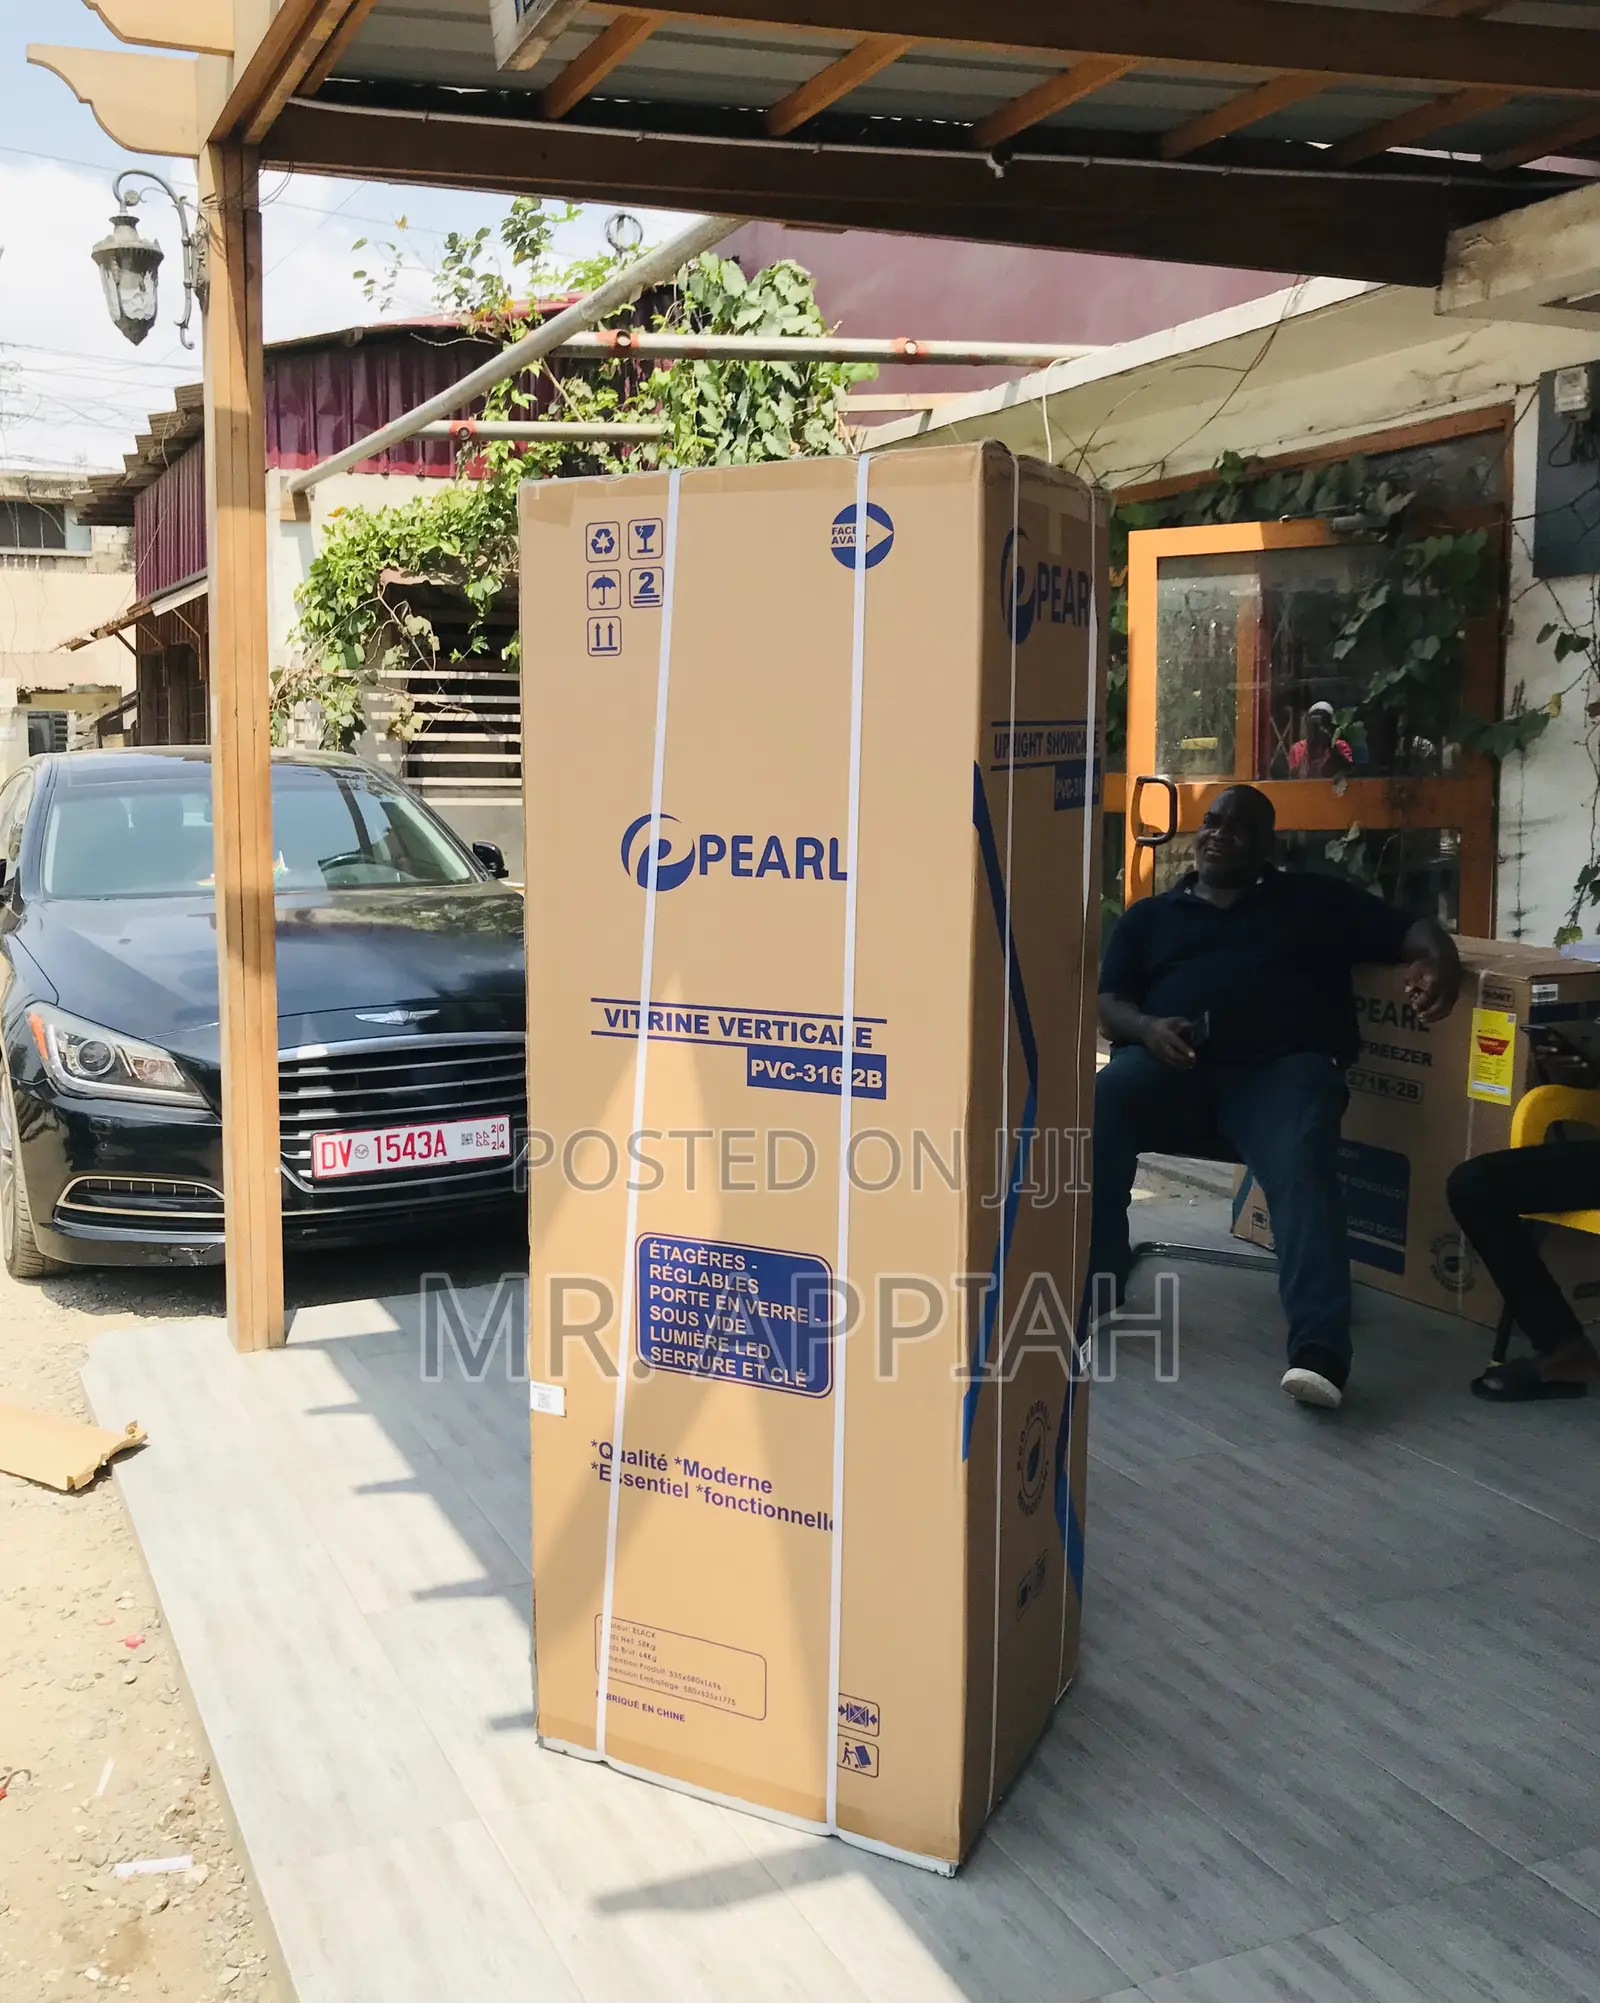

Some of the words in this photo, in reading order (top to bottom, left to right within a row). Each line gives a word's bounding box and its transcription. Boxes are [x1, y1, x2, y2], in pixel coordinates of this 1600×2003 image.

[1037, 561, 1099, 629] PEAR
[1046, 731, 1099, 756] SHOWCAE
[700, 834, 848, 881] PEARL
[604, 1008, 709, 1035] VITRINE
[321, 1139, 352, 1170] DV
[373, 1129, 448, 1164] 1543A
[650, 1240, 746, 1271] ÉTAGÈRES
[650, 1263, 759, 1295] RÉGLABLES
[650, 1285, 710, 1308] PORTE
[716, 1295, 740, 1313] EN
[745, 1299, 809, 1324] VERRE
[650, 1306, 699, 1327] SOUS
[704, 1313, 746, 1335] VIDE
[650, 1325, 729, 1352] LUMIÈRE
[735, 1340, 771, 1360] LED
[650, 1346, 736, 1375] SERRURE
[742, 1361, 765, 1379] ET
[770, 1367, 807, 1388] CLÉ
[590, 1461, 689, 1499] Esentiel
[632, 1627, 657, 1638] BLACK
[596, 1690, 640, 1709] BRIQUÉ
[642, 1703, 655, 1714] EN
[656, 1708, 686, 1722] CHINE
